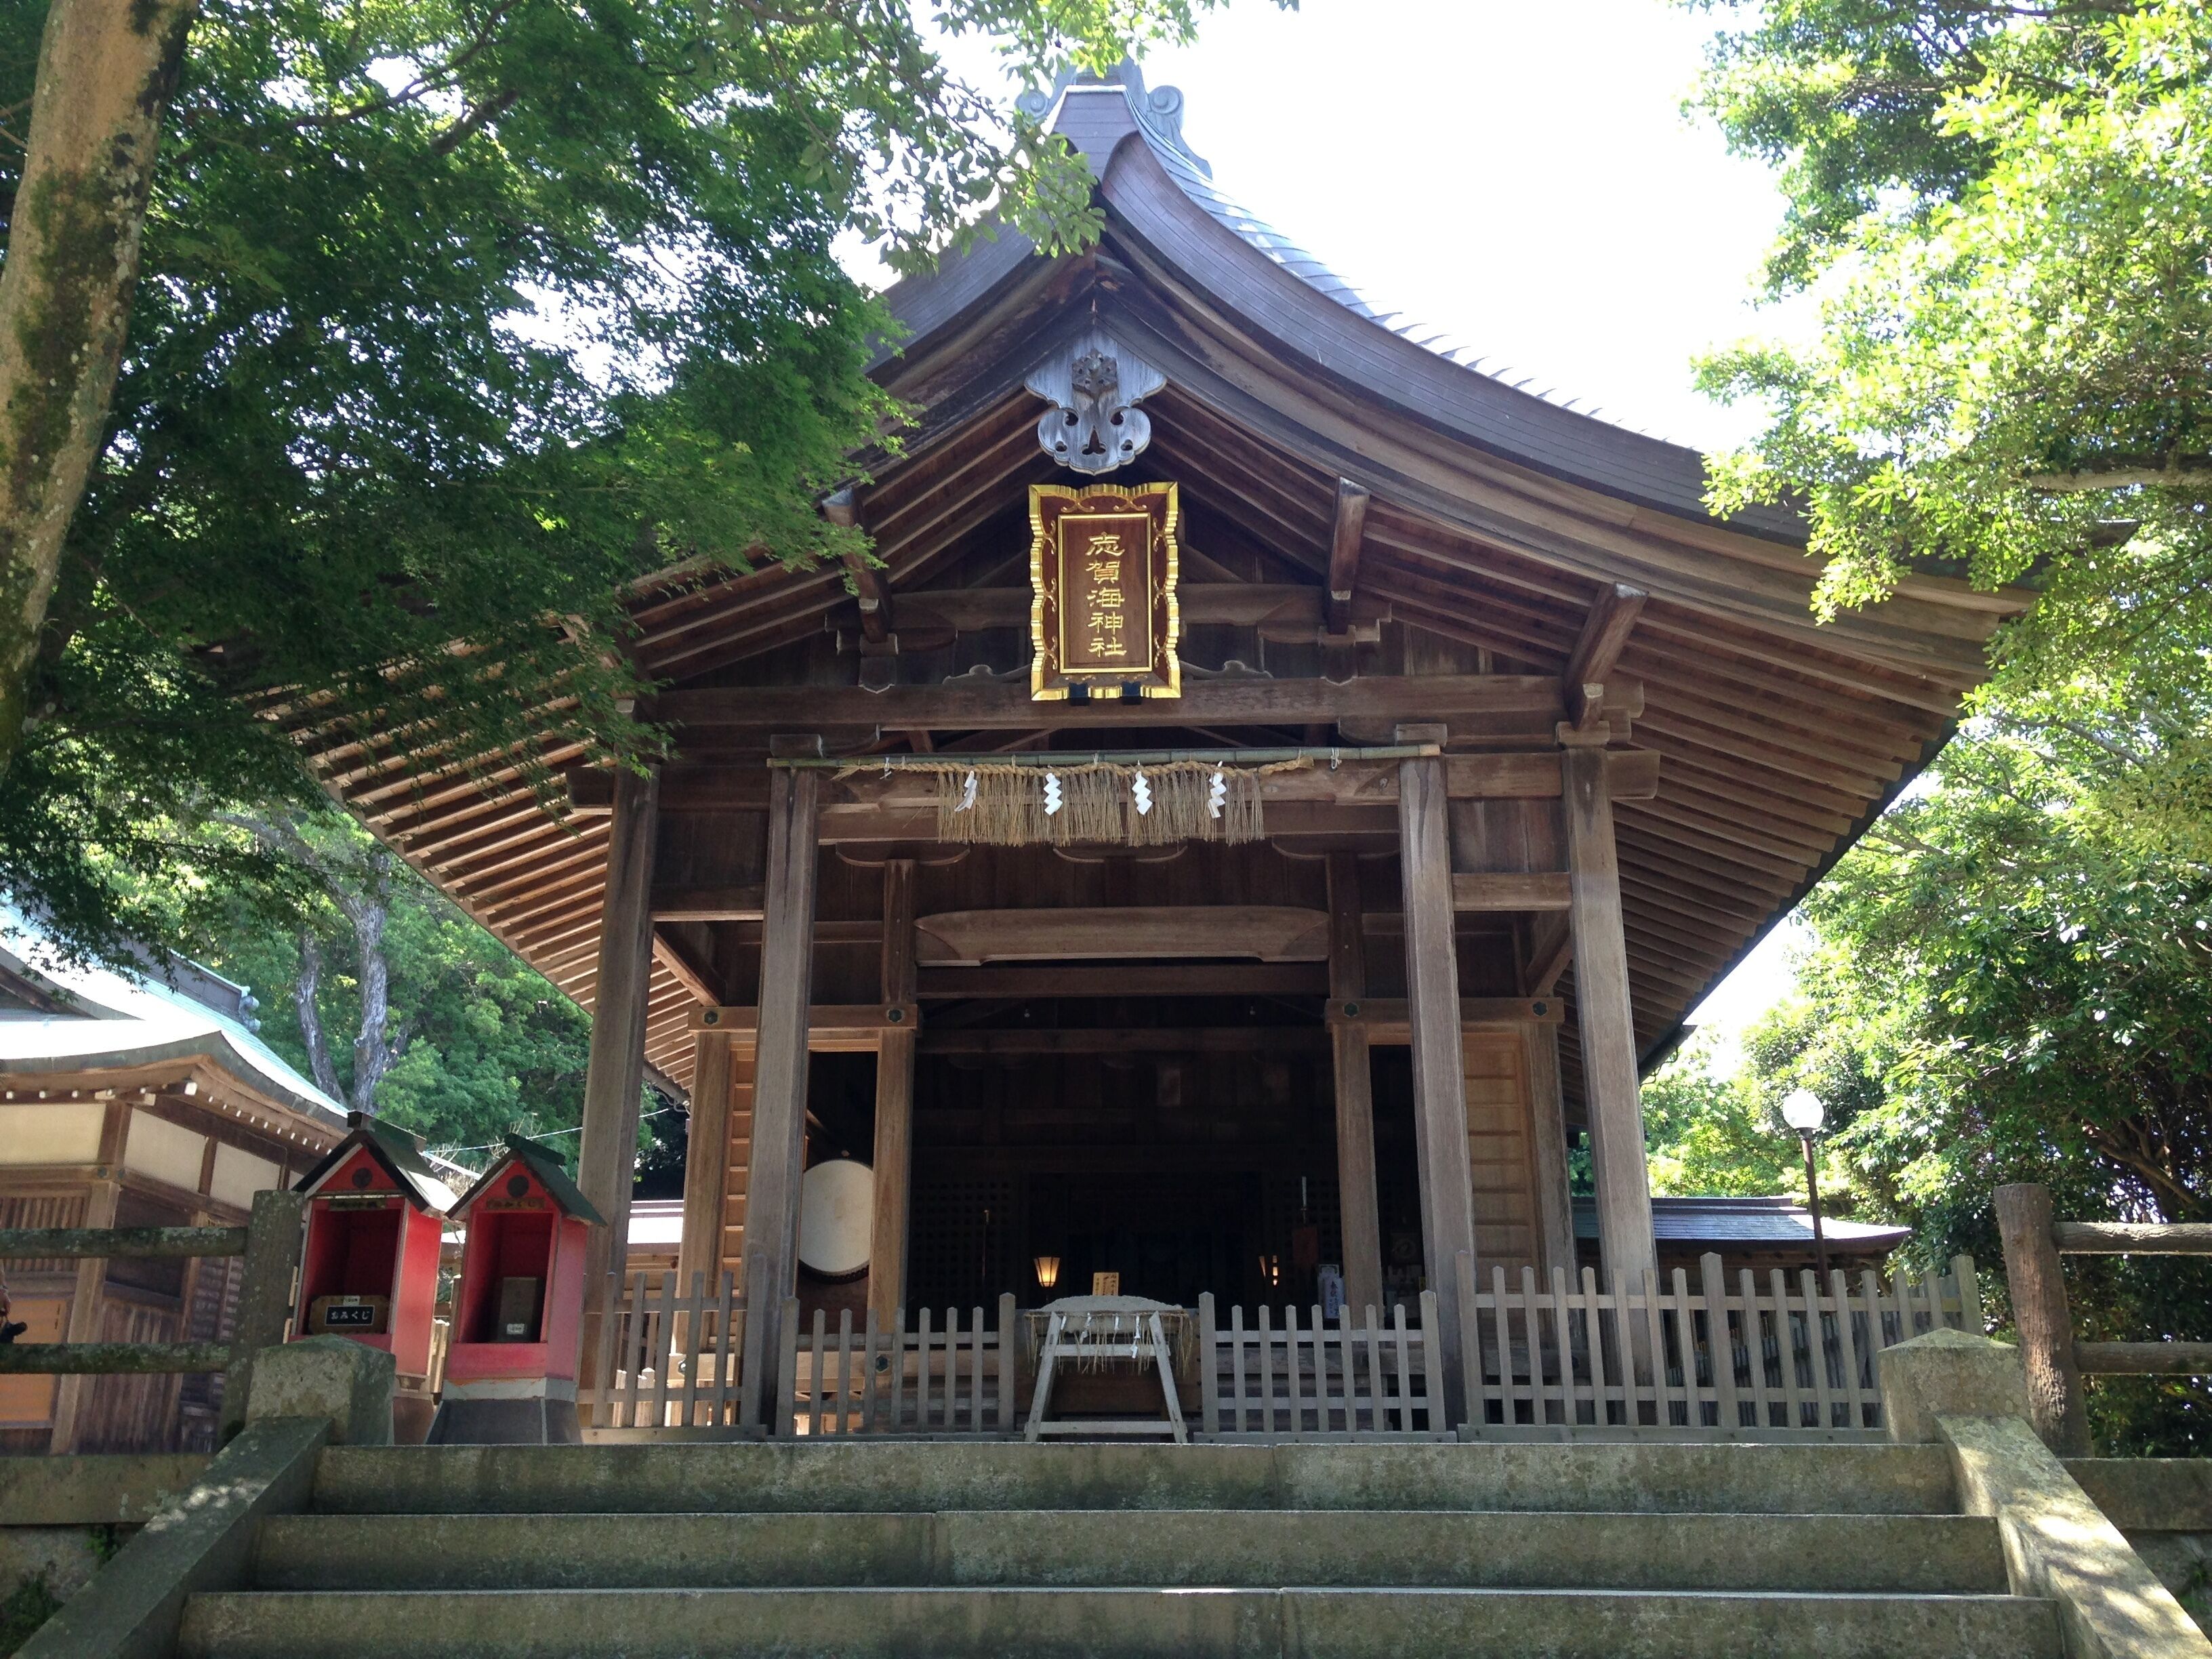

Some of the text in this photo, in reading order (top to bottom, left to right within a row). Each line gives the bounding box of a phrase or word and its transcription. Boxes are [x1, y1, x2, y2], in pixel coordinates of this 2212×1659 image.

[1086, 531, 1127, 658] 志賀海神社
[331, 1310, 370, 1320] おみくじ
